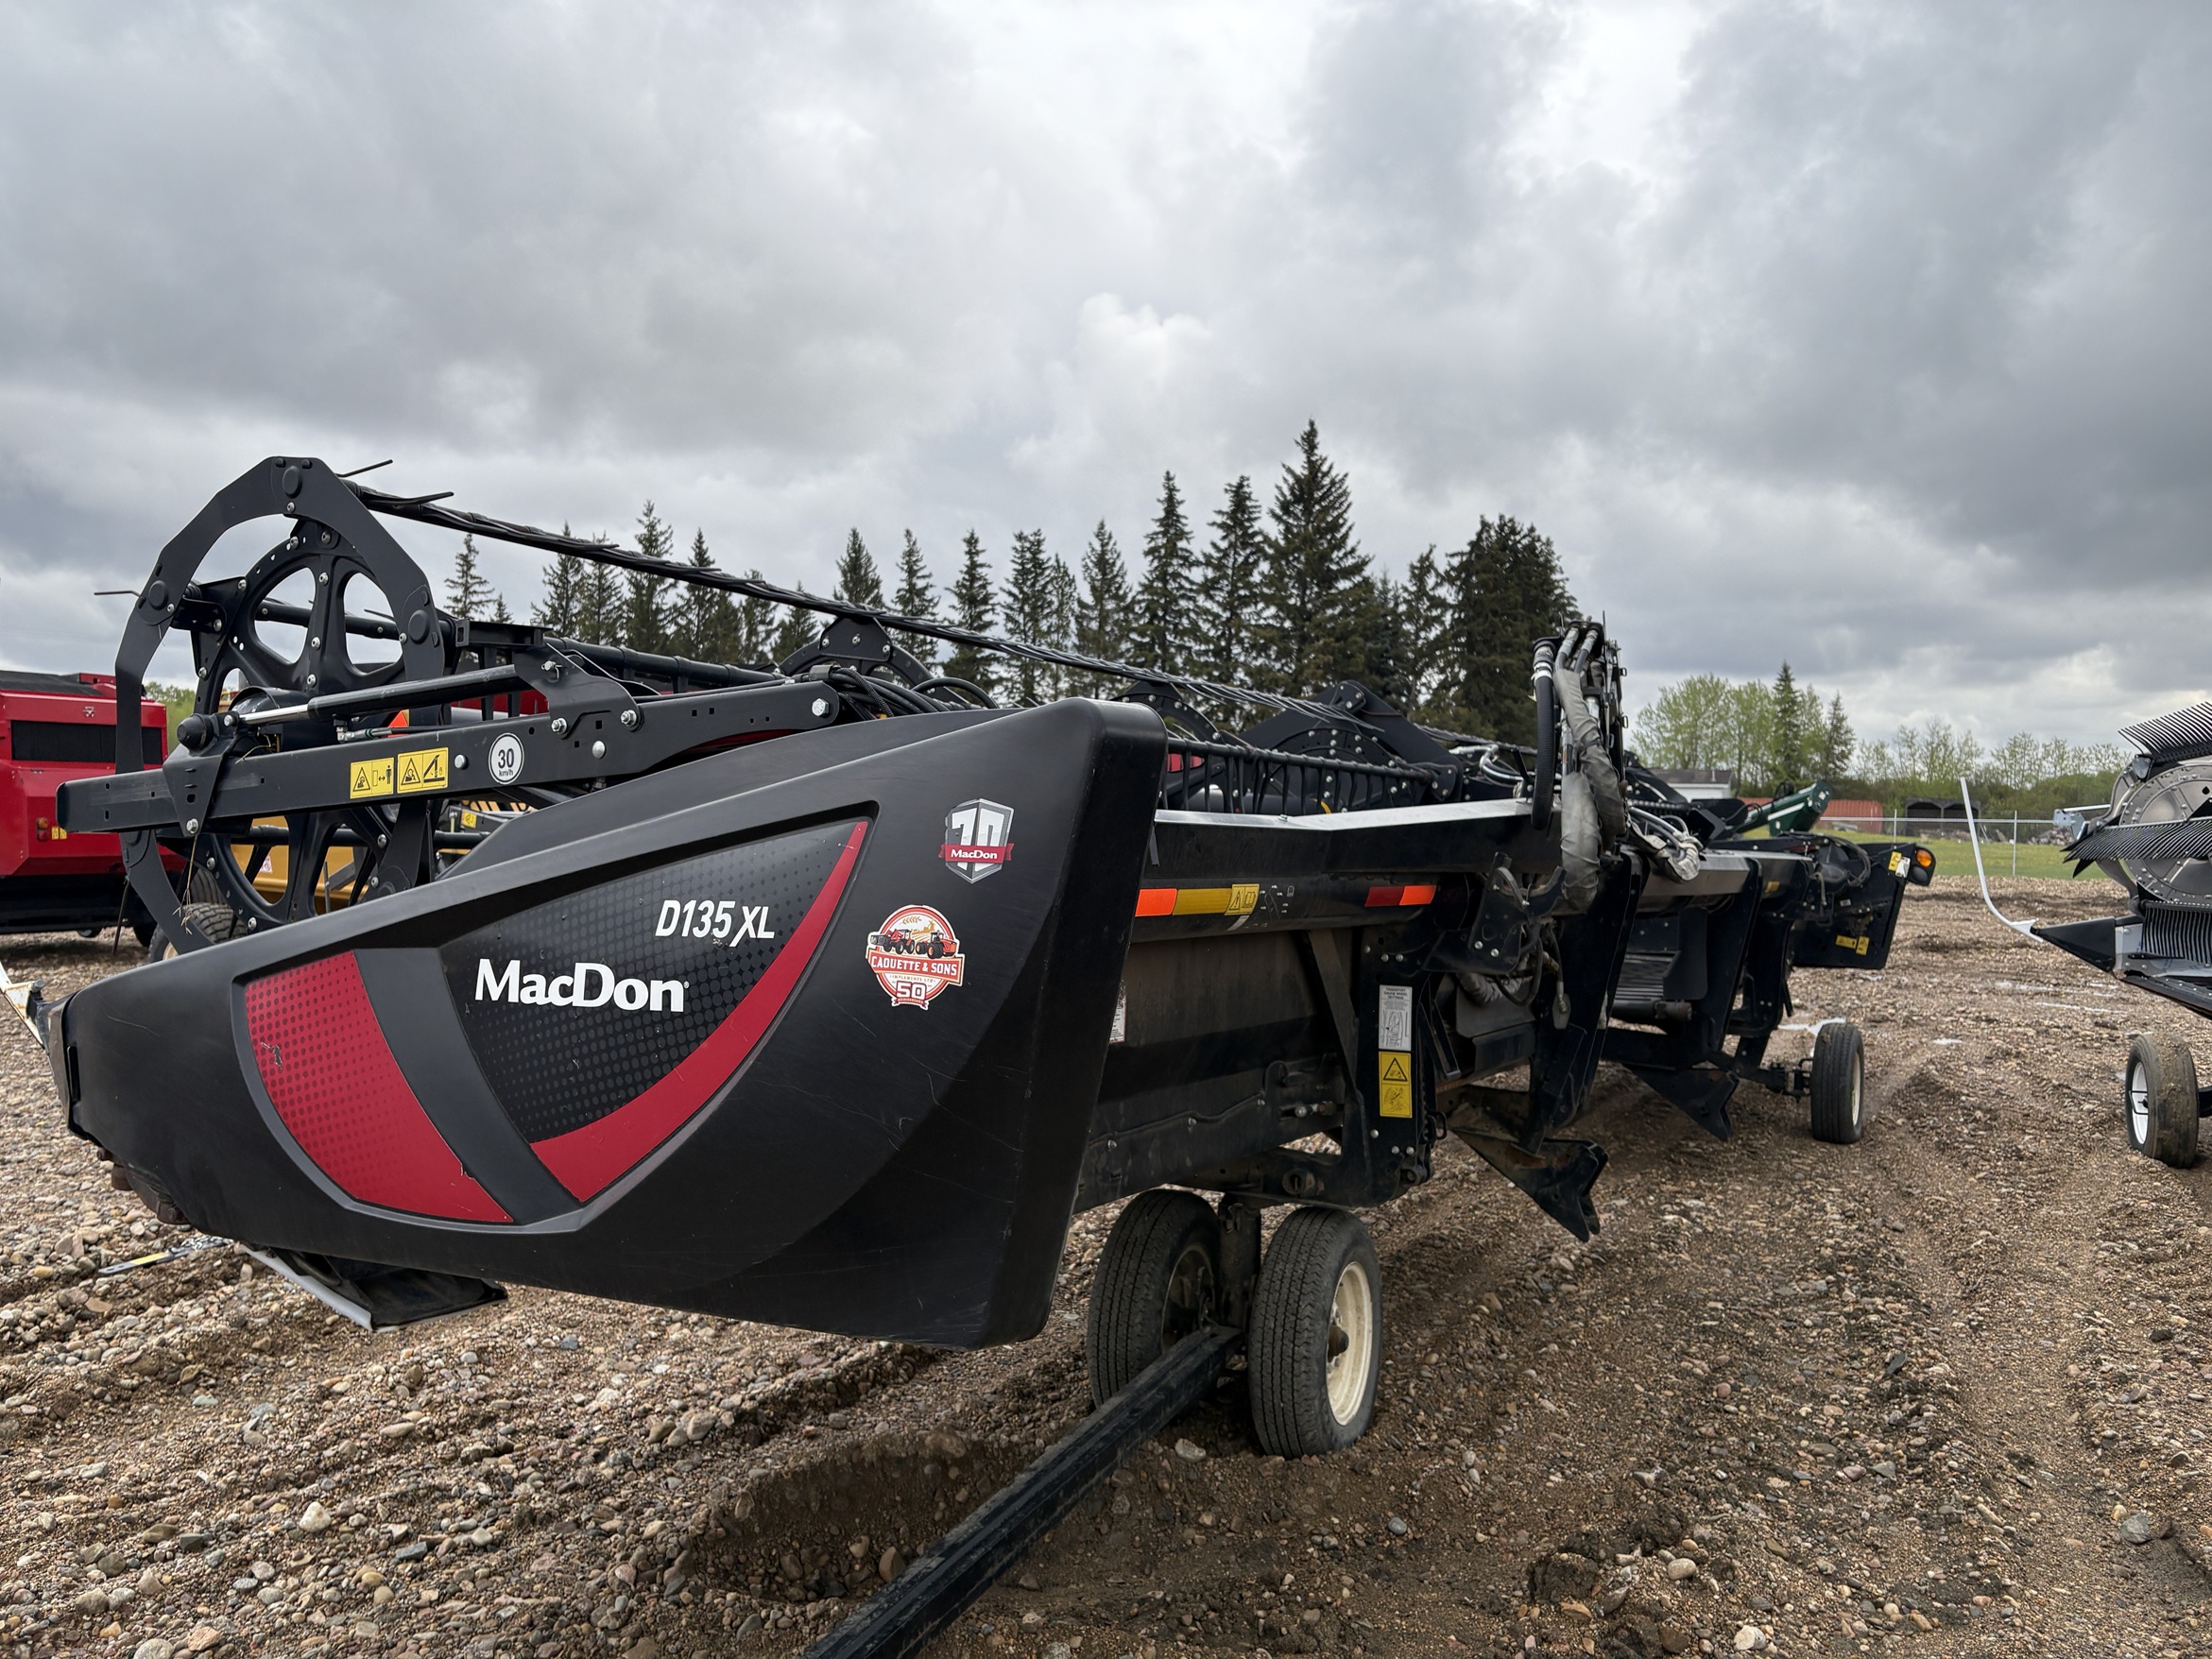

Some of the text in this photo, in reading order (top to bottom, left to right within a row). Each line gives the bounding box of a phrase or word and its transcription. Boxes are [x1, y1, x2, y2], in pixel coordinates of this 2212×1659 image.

[498, 747, 515, 769] 30
[951, 848, 998, 860] MacDon
[870, 956, 957, 976] CAOUETTE & SONS
[474, 958, 684, 1012] MacDon
[897, 981, 927, 1000] 50
